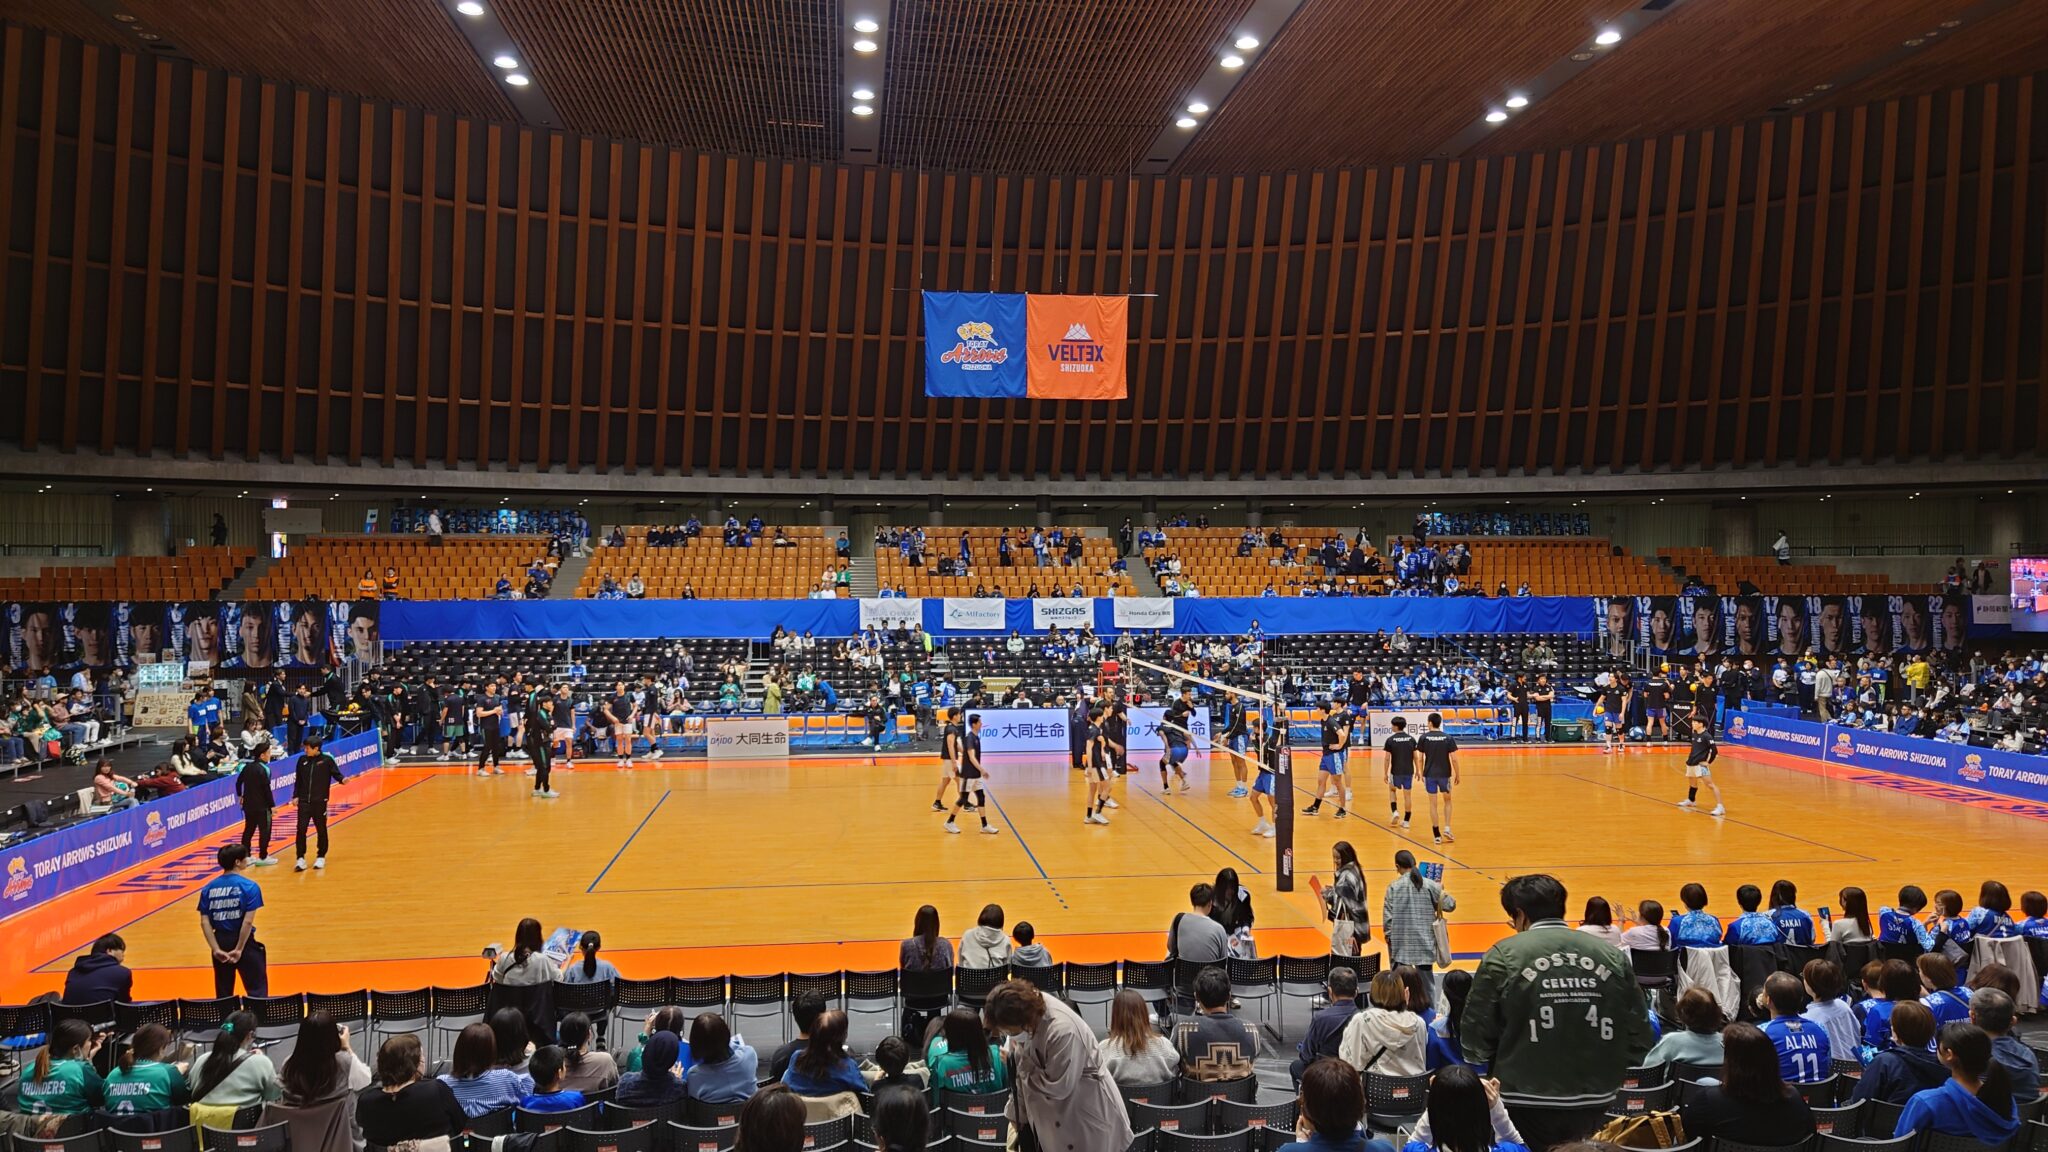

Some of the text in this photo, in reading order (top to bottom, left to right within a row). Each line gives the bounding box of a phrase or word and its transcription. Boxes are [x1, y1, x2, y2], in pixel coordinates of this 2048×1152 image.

[967, 340, 988, 348] TORAY
[941, 343, 1007, 364] Arrows
[1060, 363, 1094, 373] SHIZUOKA
[64, 602, 75, 623] 4
[118, 602, 129, 623] 5
[226, 602, 237, 621] 7
[280, 602, 291, 622] 8
[330, 602, 350, 622] 10
[1041, 607, 1086, 615] SHIZGAS
[1594, 597, 1608, 614] 11
[1637, 597, 1651, 613] 12
[1679, 597, 1694, 614] 15
[1722, 597, 1737, 614] 16
[1764, 596, 1779, 614] 17
[1806, 596, 1821, 614] 18
[1847, 596, 1862, 614] 19
[1888, 595, 1904, 613] 20
[1928, 595, 1943, 613] 22
[10, 603, 21, 624] 3
[1725, 616, 1736, 646] KAMIJO
[735, 732, 786, 745] 大同生命
[1002, 723, 1065, 739] 大同生命
[1747, 725, 1821, 746] TORAY ARROWS SHIZUOKA
[710, 735, 732, 746] DAIDO
[1856, 743, 1947, 768] TORAY ARROWS SHIZUOKA
[1988, 765, 2048, 785] TORAY ARROW
[166, 793, 236, 831] TORAY ARROWS SHIZUOKA
[33, 831, 133, 879] TORAY ARROWS SHIZUOKA
[209, 886, 233, 898] TORAY
[1779, 919, 1802, 928] SAKAI
[1521, 953, 1612, 982] BOSTON
[1541, 978, 1597, 988] CELTICS
[1785, 1034, 1818, 1050] ALAN
[1791, 1053, 1819, 1083] 11
[22, 1080, 66, 1096] THUNDERS
[109, 1082, 151, 1097] THUNDERS
